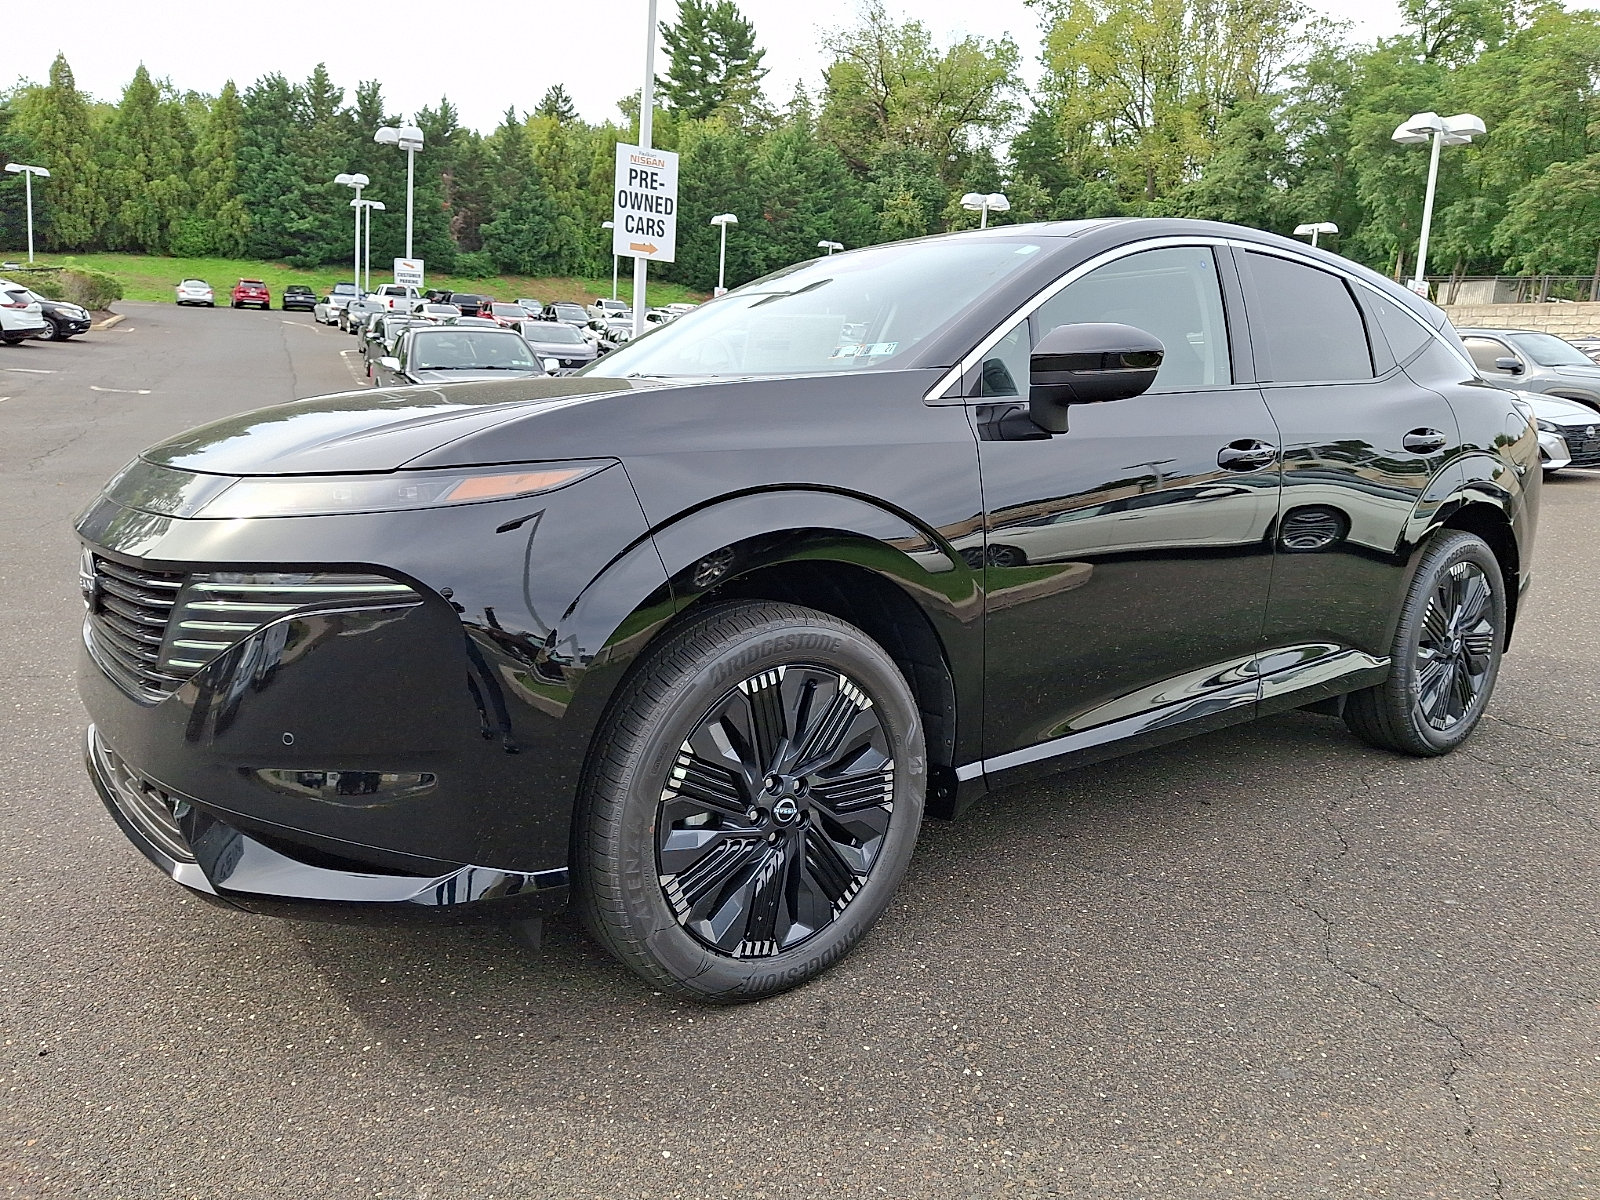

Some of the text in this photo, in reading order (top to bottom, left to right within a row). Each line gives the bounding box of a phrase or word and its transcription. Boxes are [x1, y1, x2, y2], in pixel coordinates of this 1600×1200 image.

[630, 154, 665, 168] NISSAN
[628, 168, 665, 191] PRE-
[618, 189, 674, 216] OWNED
[625, 214, 666, 238] CARS
[709, 632, 840, 685] BRIDGESTONE
[739, 922, 863, 994] BRIDGESTONE
